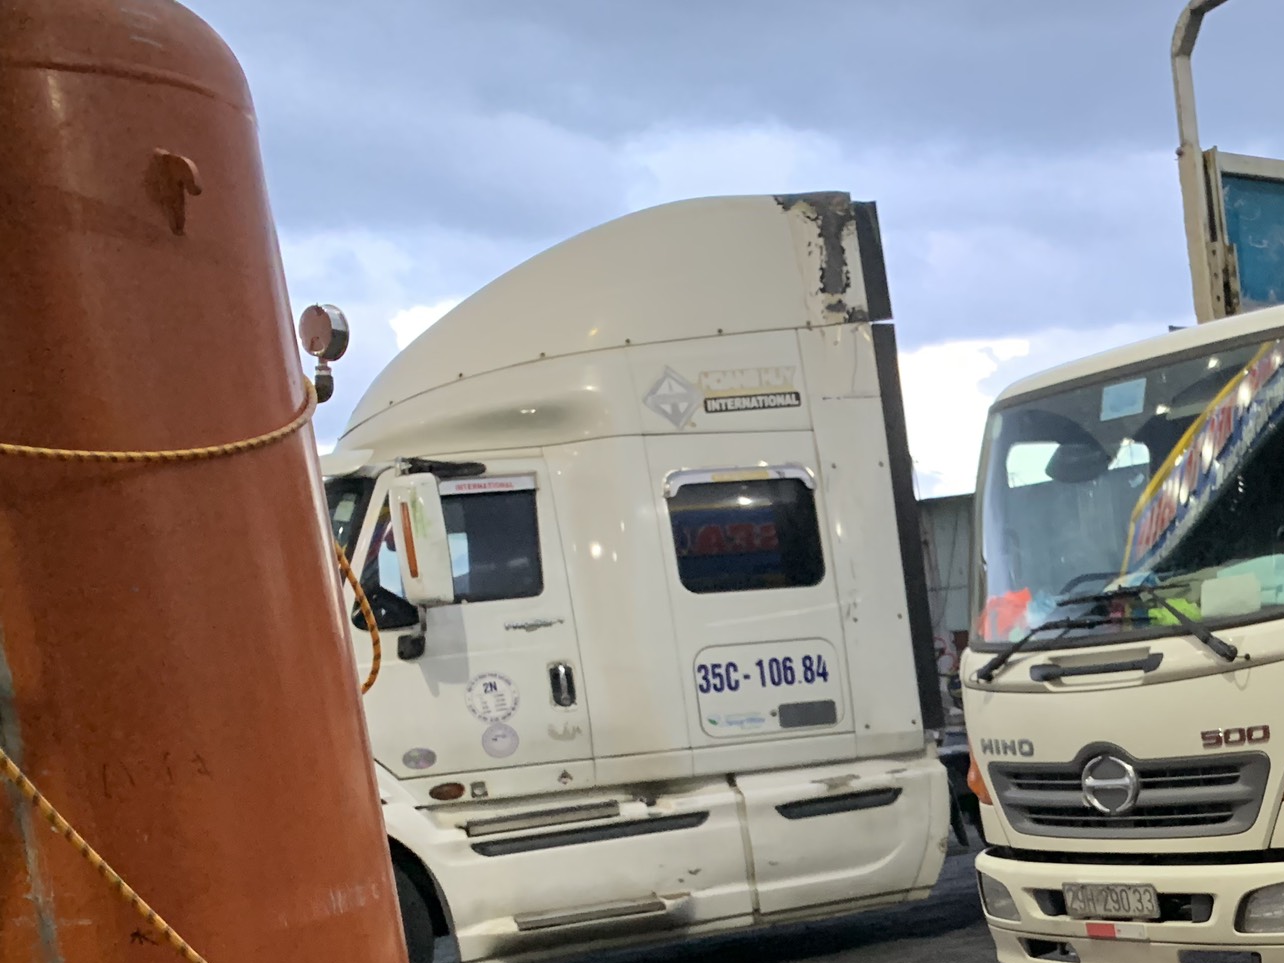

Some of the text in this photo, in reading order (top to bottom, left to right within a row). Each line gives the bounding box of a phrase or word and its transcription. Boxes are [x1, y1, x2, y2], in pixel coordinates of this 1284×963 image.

[707, 393, 800, 412] INTERNATIONAL
[483, 681, 498, 694] 2N
[1200, 725, 1270, 749] 500
[981, 738, 1035, 757] HINO
